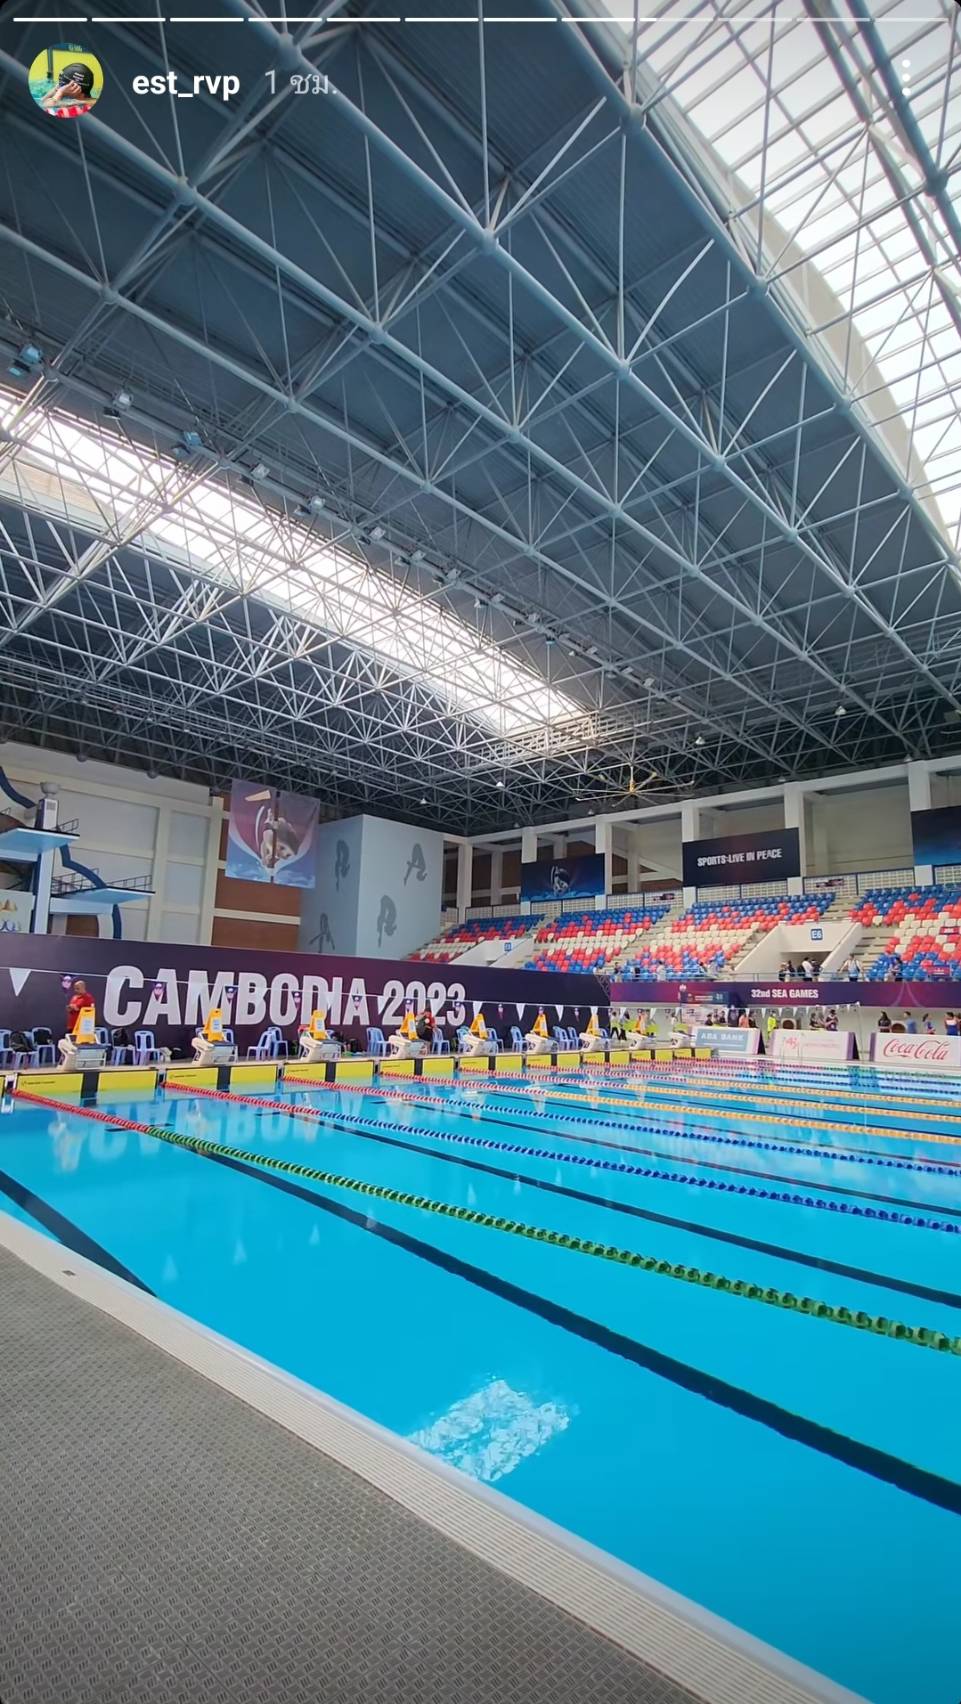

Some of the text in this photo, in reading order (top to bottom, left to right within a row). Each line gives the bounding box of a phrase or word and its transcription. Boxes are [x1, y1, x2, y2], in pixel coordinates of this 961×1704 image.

[746, 851, 756, 862] IN
[756, 848, 782, 860] PEACE
[103, 965, 466, 1027] CAMBODIA 2023
[751, 989, 819, 999] 32nd SEA GAMES
[720, 1033, 745, 1041] BANK
